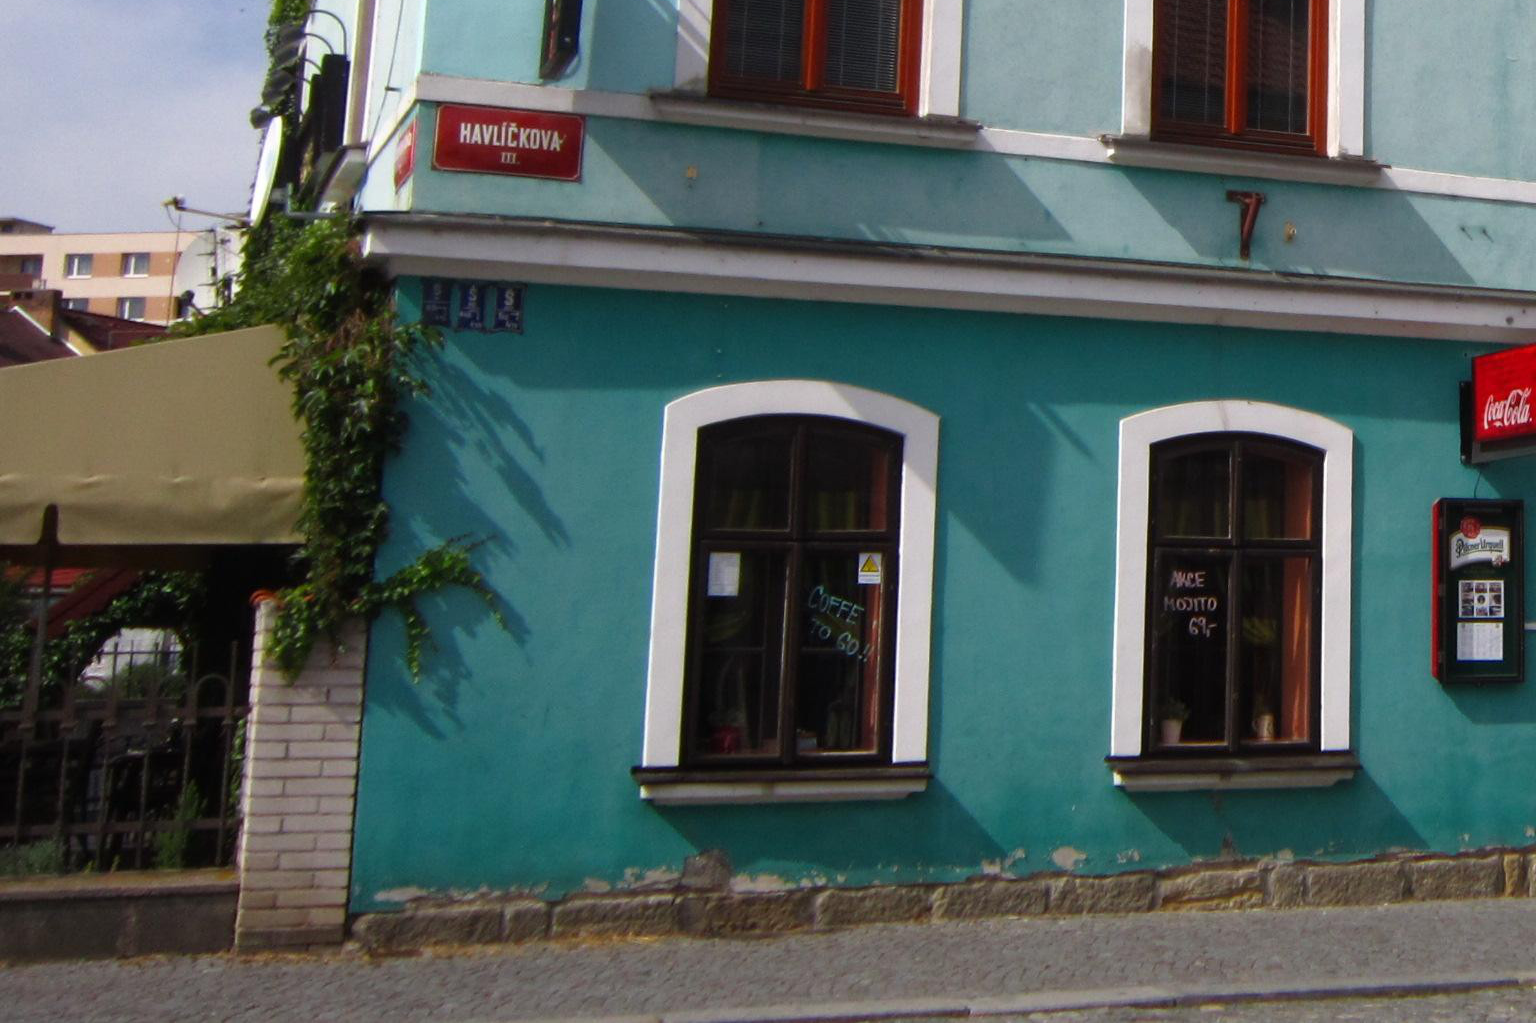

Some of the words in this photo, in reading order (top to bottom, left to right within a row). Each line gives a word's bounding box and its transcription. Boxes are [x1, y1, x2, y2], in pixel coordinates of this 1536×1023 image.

[460, 122, 561, 152] HAVLÍČKOVA
[808, 585, 865, 625] COFFE
[1164, 596, 1217, 612] MOJITO
[811, 617, 832, 639] TO
